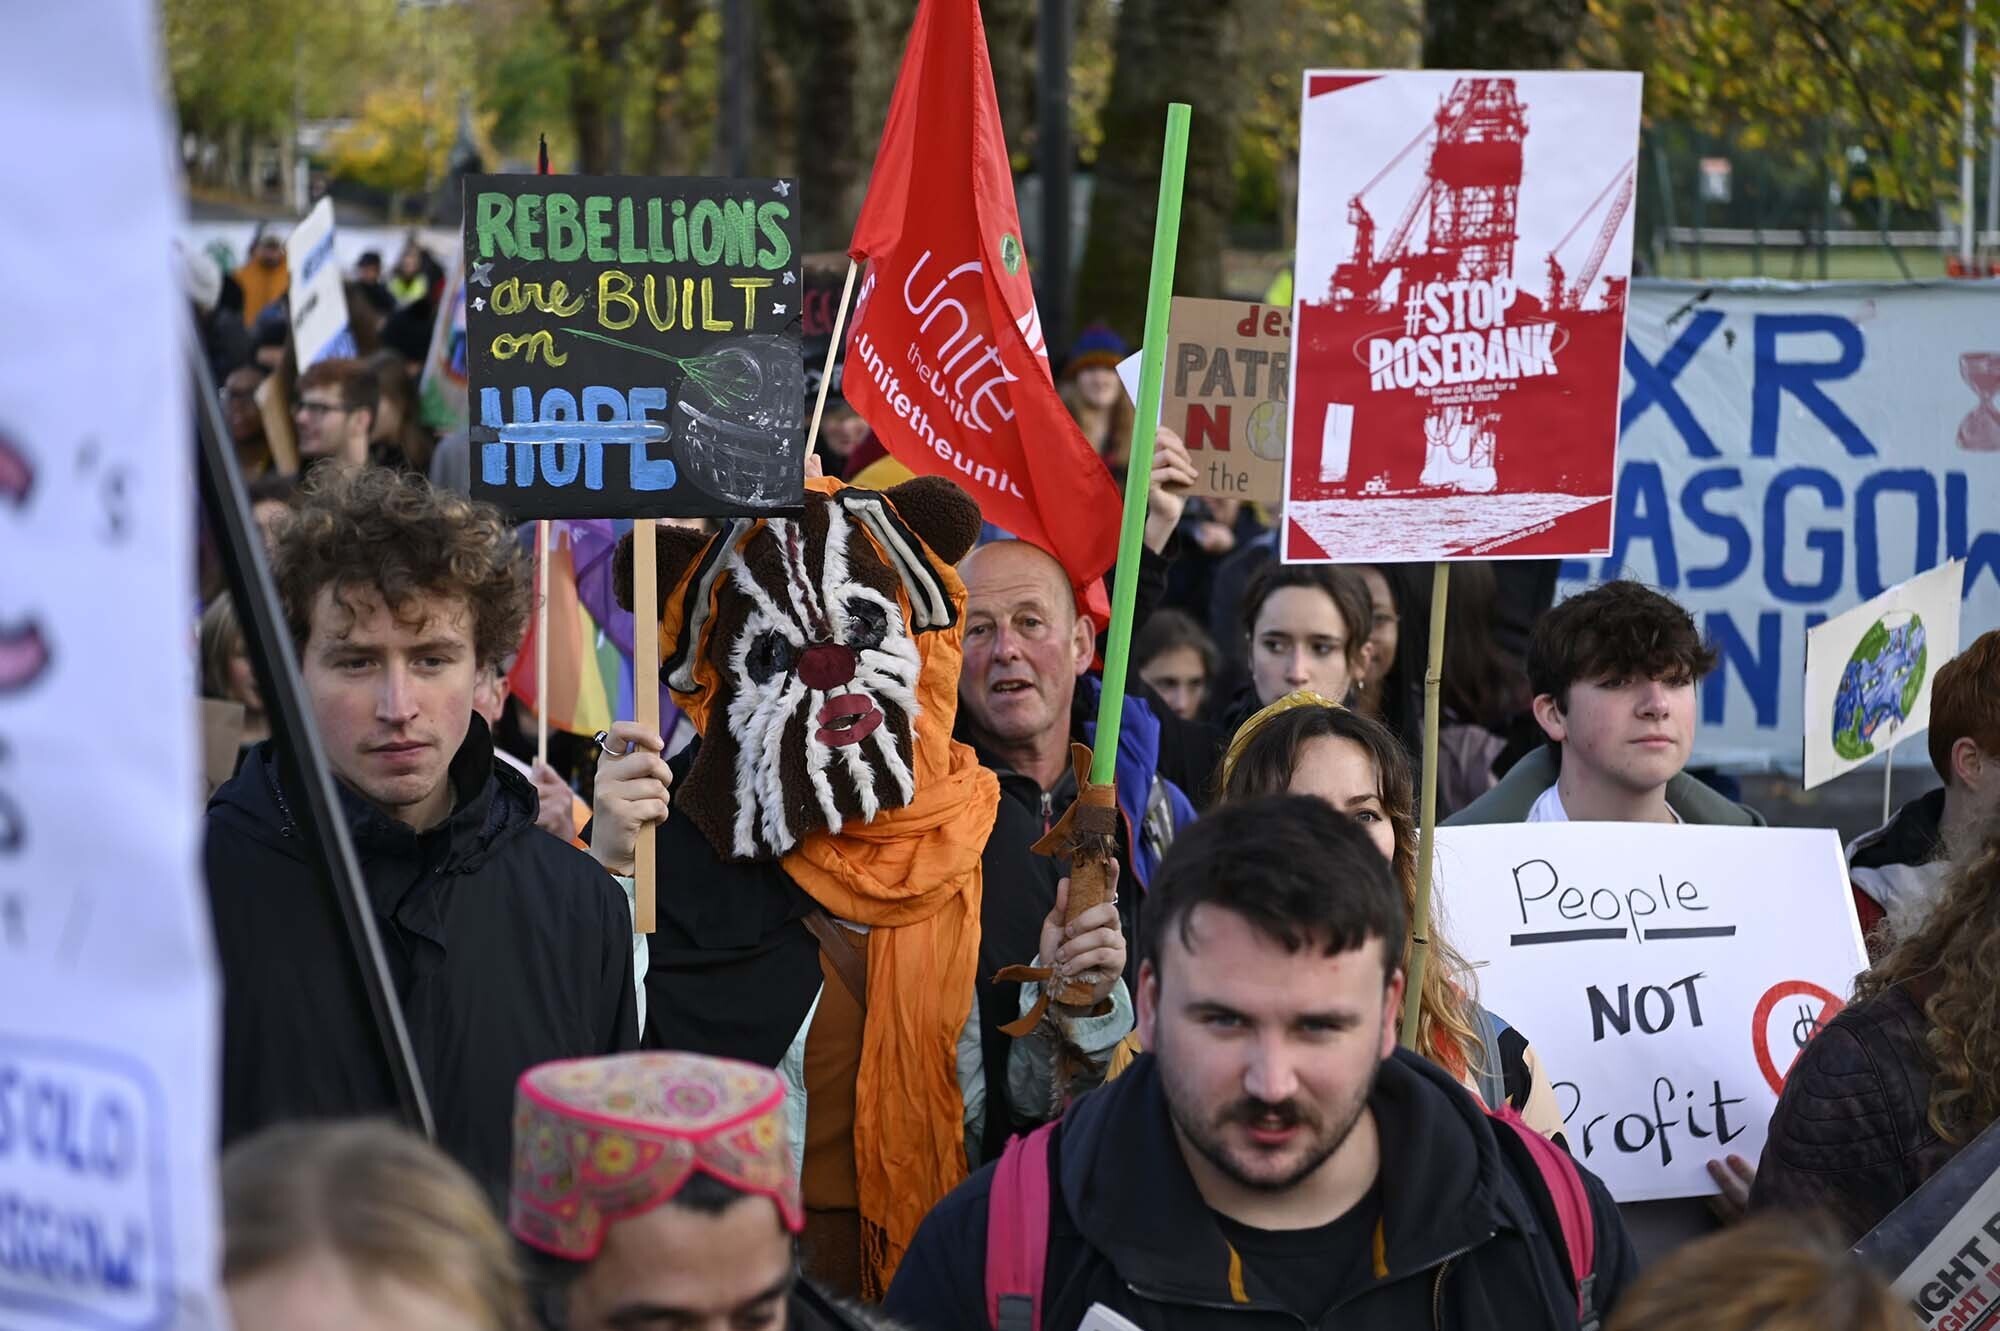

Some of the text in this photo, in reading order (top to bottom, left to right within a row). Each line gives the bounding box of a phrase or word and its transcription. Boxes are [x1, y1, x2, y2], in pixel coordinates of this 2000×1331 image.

[490, 277, 586, 317] are
[598, 270, 775, 332] BUILT
[1403, 278, 1517, 336] #STOP
[491, 329, 569, 368] on
[1368, 322, 1559, 392] ROSEBANK
[1620, 310, 1879, 458] XR
[479, 385, 678, 491] HOPE
[1208, 460, 1250, 492] the
[1558, 459, 2000, 610] ASGOW
[1512, 859, 1710, 945] People
[1585, 971, 1708, 1042] NOT
